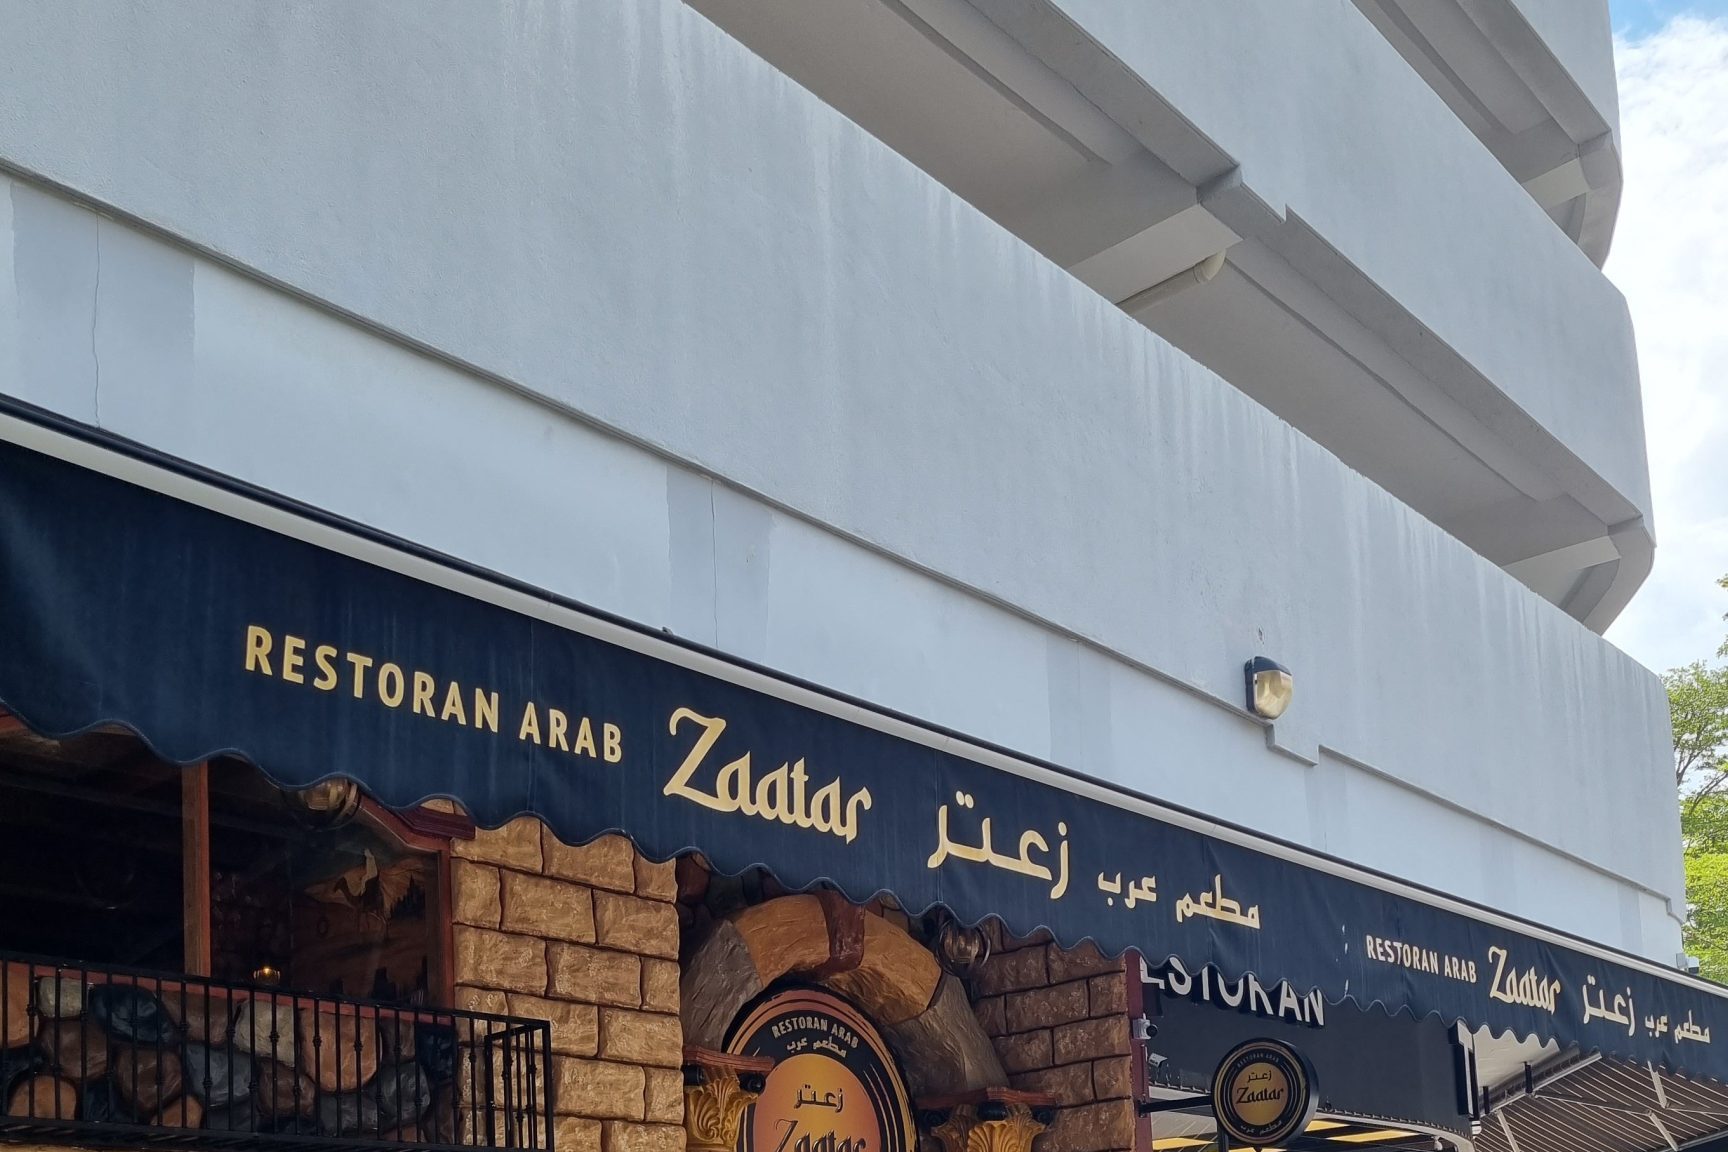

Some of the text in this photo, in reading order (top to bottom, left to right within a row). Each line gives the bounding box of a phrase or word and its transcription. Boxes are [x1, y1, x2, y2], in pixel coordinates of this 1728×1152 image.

[245, 625, 622, 763] RESTORAN ARAB
[663, 707, 872, 844] Zaatar
[927, 790, 1070, 900] زعتر
[1097, 871, 1261, 930] مطعم عرب
[1366, 935, 1477, 983] RESTORAN ARAB
[1488, 946, 1561, 1015] Zaatar
[771, 1016, 859, 1049] RESTORAN ARAB
[1582, 975, 1636, 1037] زعتر
[794, 1084, 844, 1113] زعتر
[1236, 1086, 1284, 1105] Zaatar
